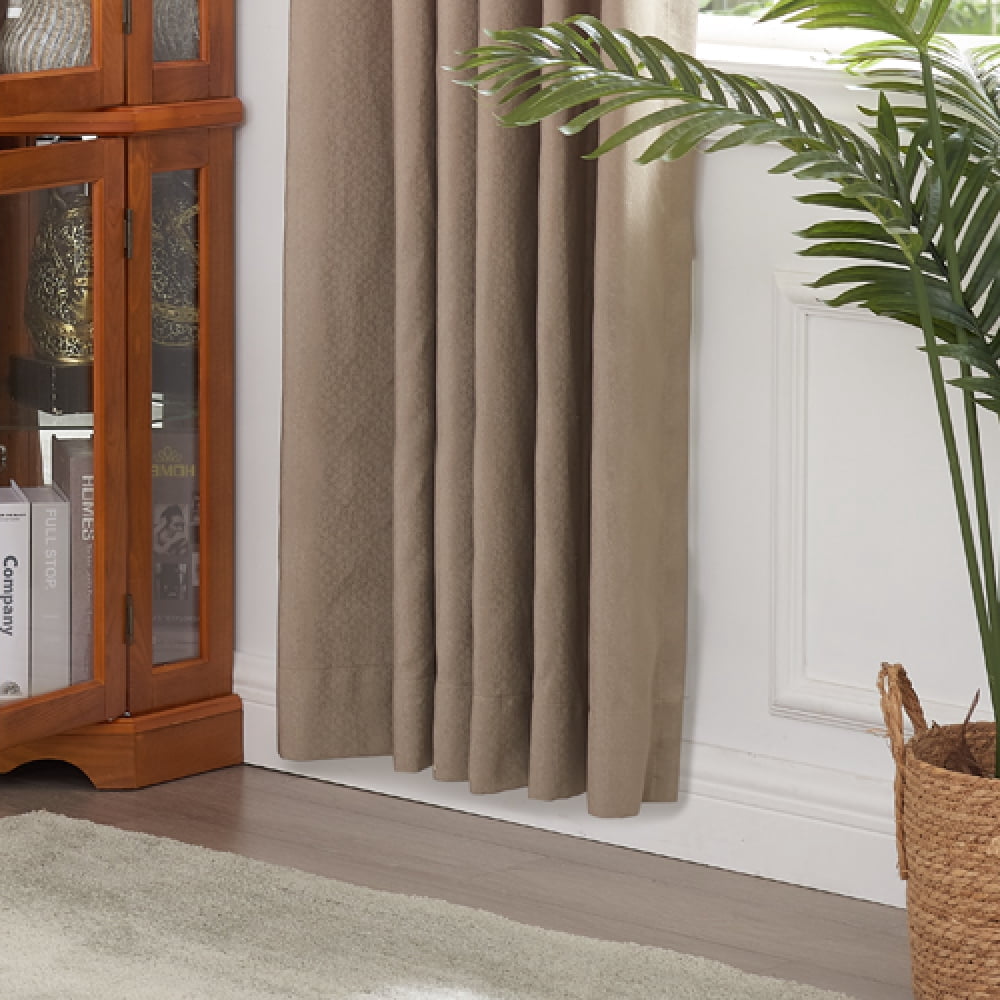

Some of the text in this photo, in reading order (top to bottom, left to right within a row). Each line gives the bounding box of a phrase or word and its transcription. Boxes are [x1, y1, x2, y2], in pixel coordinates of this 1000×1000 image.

[46, 508, 57, 546] FULL
[81, 474, 95, 541] HOMES
[0, 554, 19, 637] Company
